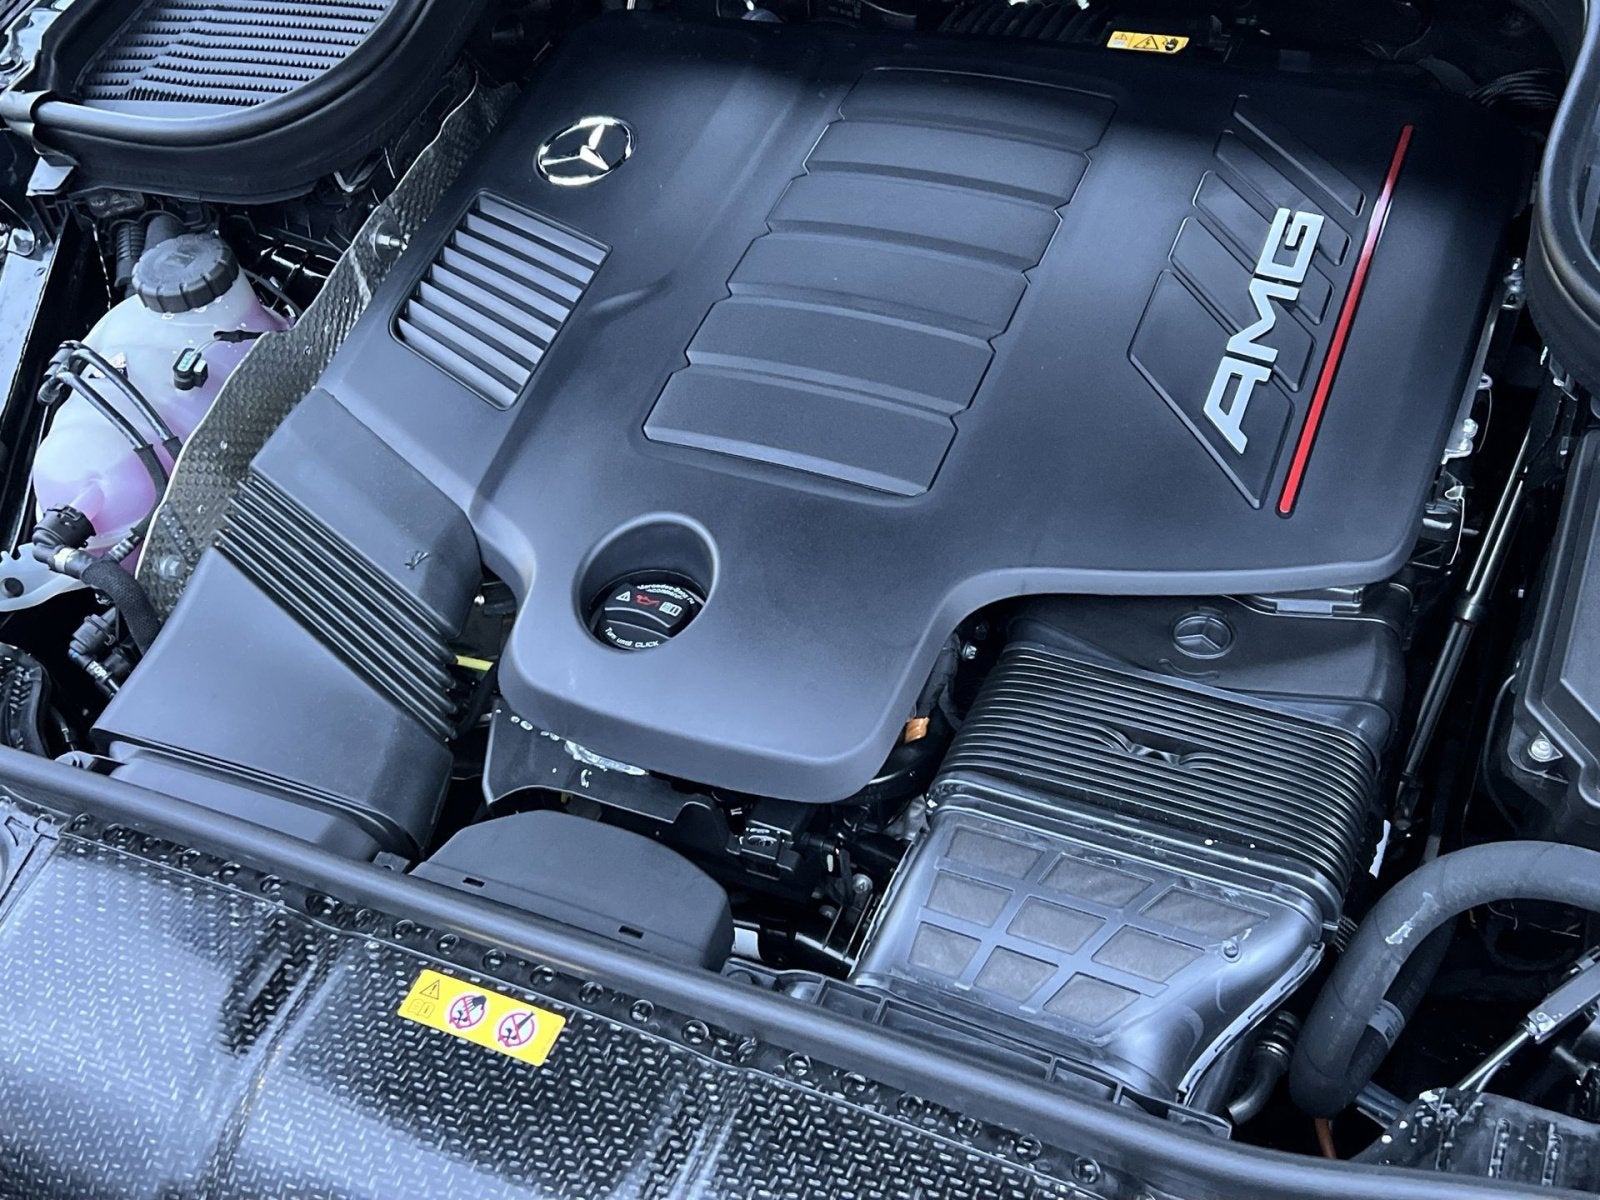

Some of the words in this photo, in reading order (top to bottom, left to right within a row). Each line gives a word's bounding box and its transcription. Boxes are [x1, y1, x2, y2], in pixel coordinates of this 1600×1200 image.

[1203, 207, 1325, 455] AMG
[605, 627, 616, 639] Turn
[635, 640, 659, 648] CLICK
